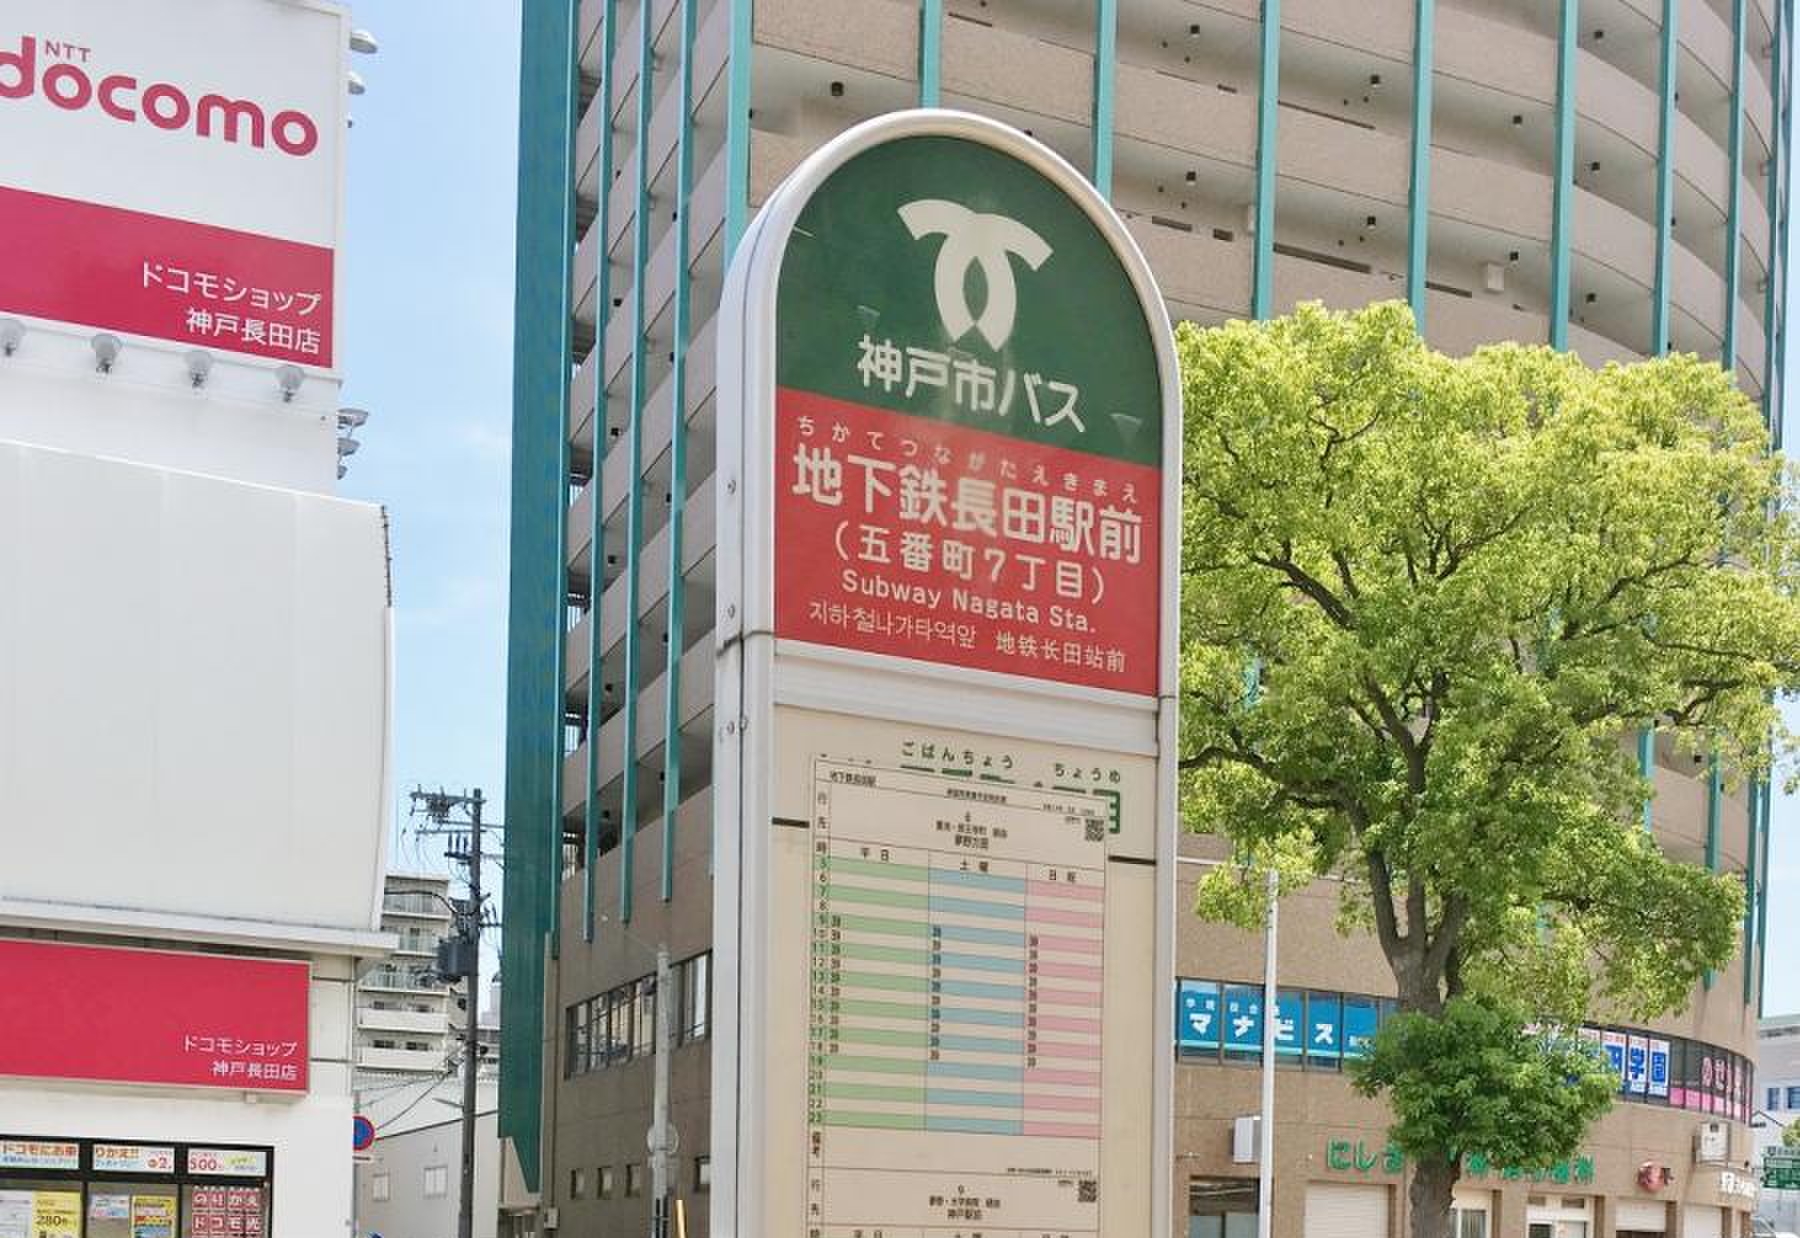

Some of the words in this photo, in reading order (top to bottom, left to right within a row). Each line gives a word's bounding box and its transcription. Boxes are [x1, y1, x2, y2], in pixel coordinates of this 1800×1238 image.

[45, 40, 91, 63] NTT
[0, 36, 319, 157] docomo
[142, 262, 322, 316] ドコモショップ
[186, 307, 322, 355] 神戸長田店
[857, 335, 1085, 433] 神戸市バス
[798, 415, 1138, 504] ちかてつながたえきまえ
[792, 444, 1143, 565] 地下鉄長田駅前
[842, 570, 941, 609] Subway
[953, 588, 1039, 624] Nagata
[1050, 605, 1097, 633] Sta.
[996, 631, 1126, 673] 地铁长田站前
[184, 1034, 298, 1057] ドコモショップ
[1189, 1013, 1334, 1045] マナビス
[212, 1060, 298, 1081] 神戸長田店
